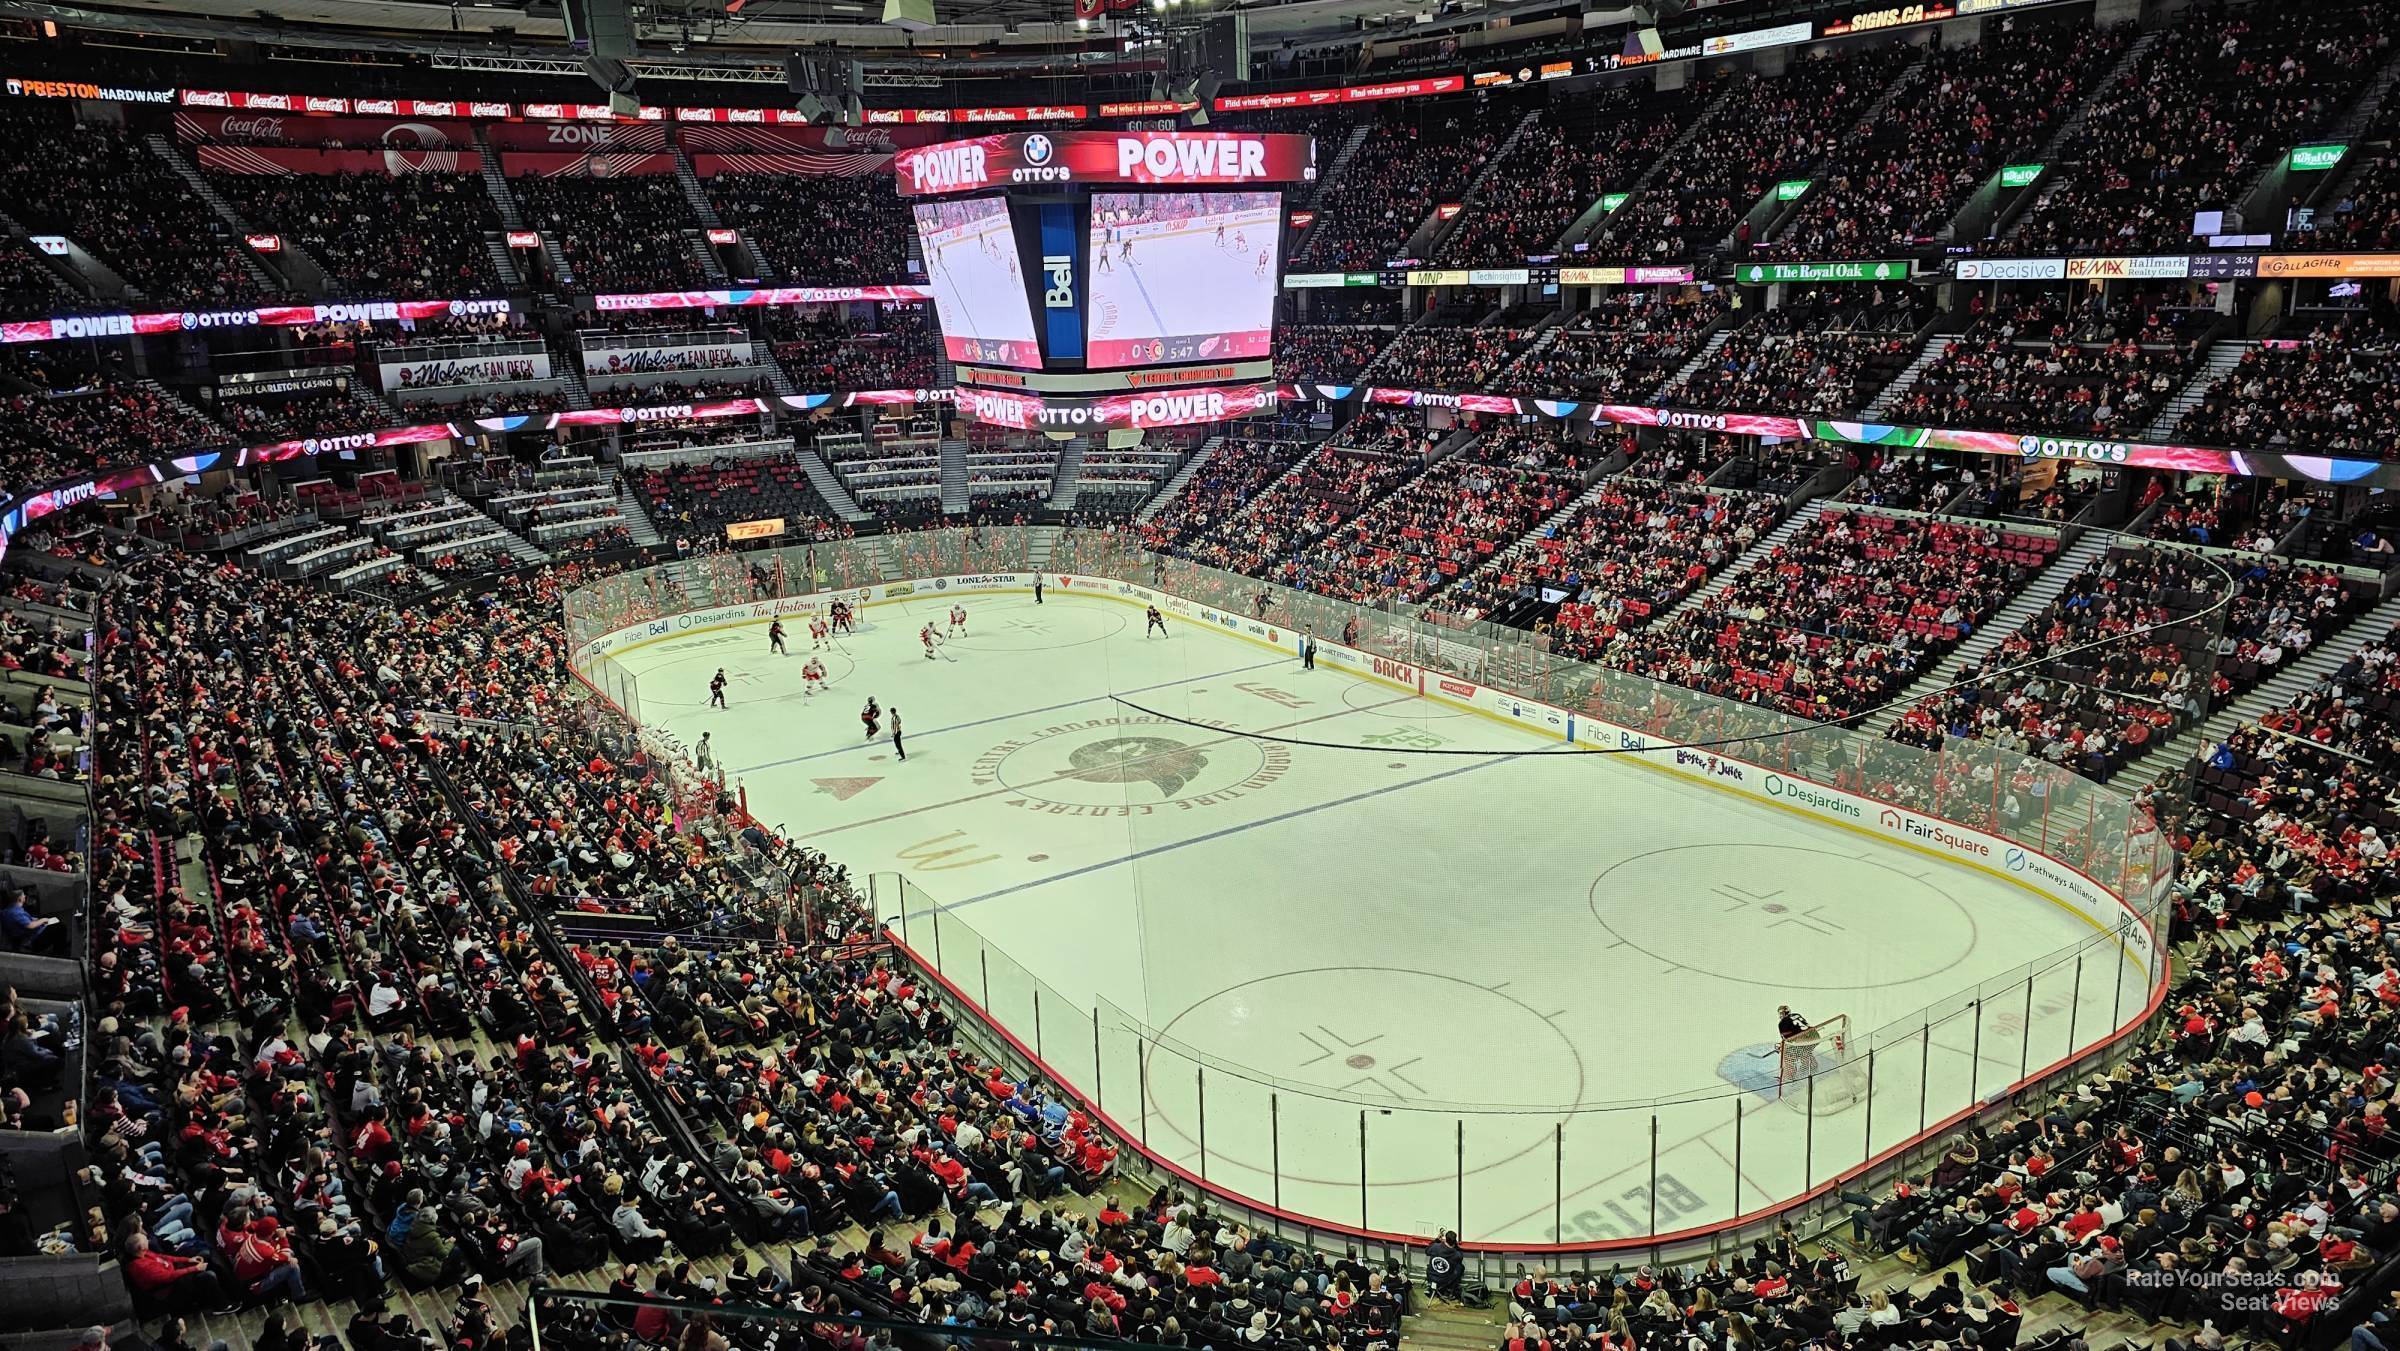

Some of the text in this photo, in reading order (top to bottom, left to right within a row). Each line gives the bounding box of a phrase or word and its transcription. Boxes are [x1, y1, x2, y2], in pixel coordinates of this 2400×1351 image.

[1850, 5, 1924, 31] SIGNS.CA
[1350, 83, 1420, 97] Find what moves you
[1102, 104, 1118, 114] Find
[1119, 104, 1136, 113] what
[1159, 103, 1173, 113] you
[1225, 96, 1296, 108] Find what moves you
[967, 109, 1015, 122] Tim Hortons
[1027, 107, 1075, 120] Tim Hortons
[221, 116, 284, 139] Coca-Cola
[1128, 119, 1175, 132] GO GO!
[547, 126, 612, 144] ZONE
[1118, 138, 1266, 177] POWER
[913, 146, 988, 190] POWER
[1012, 166, 1071, 182] OTTO'S
[2069, 258, 2186, 275] RE/MAX Hallmark
[2194, 257, 2253, 265] 323 324
[2273, 259, 2341, 272] GALLAGHER
[1476, 271, 1522, 281] TechInsights
[1561, 270, 1590, 282] RE/MAX
[1645, 269, 1682, 277] MAGENTA
[1775, 264, 1863, 280] The Royal Oak
[1981, 262, 2057, 278] Decisive
[2128, 268, 2186, 278] Realty Group
[2193, 269, 2251, 277] 223 224
[1043, 256, 1073, 307] Bell
[1417, 272, 1443, 285] MNP
[597, 295, 651, 308] OTTO'S
[814, 288, 863, 299] OTTO'S
[314, 302, 399, 322] POWER
[467, 300, 510, 313] OTTO
[199, 310, 259, 326] OTTO'S
[51, 315, 134, 338] POWER
[1132, 344, 1141, 359] 0
[1170, 346, 1193, 359] 5:47
[1223, 339, 1231, 352] 1
[622, 348, 733, 369] Molson FAN DECK
[415, 360, 534, 382] Molson FAN DECK
[219, 379, 333, 398] RIDEAU CARLETON CASINO
[1423, 393, 1461, 407] OTTO'S
[636, 405, 693, 420] OTTO'S
[975, 395, 1025, 423] POWER
[1038, 405, 1105, 425] OTTO'S
[1131, 393, 1224, 424] POWER
[1671, 413, 1726, 428] OTTO'S
[320, 433, 376, 451] OTTO'S
[2042, 440, 2126, 461] OTTO'S
[62, 481, 96, 506] OTTO'S
[737, 523, 774, 537] TSN
[957, 577, 981, 585] LONE
[751, 600, 816, 618] Tim Hortons
[1166, 595, 1190, 611] Gabriel
[694, 608, 746, 625] Desjardins
[649, 620, 668, 636] Bell
[625, 631, 642, 643] Fibe
[1336, 649, 1356, 663] FITNESS
[1362, 654, 1412, 684] The BRICK
[1587, 724, 1611, 743] Fibe
[1621, 731, 1645, 754] Bell
[1676, 749, 1743, 780] Booster Juice
[1787, 783, 1861, 818] Desjardins
[1905, 818, 1989, 857] FairSquare
[2029, 861, 2097, 905] Pathways Alliance
[825, 925, 841, 940] 40
